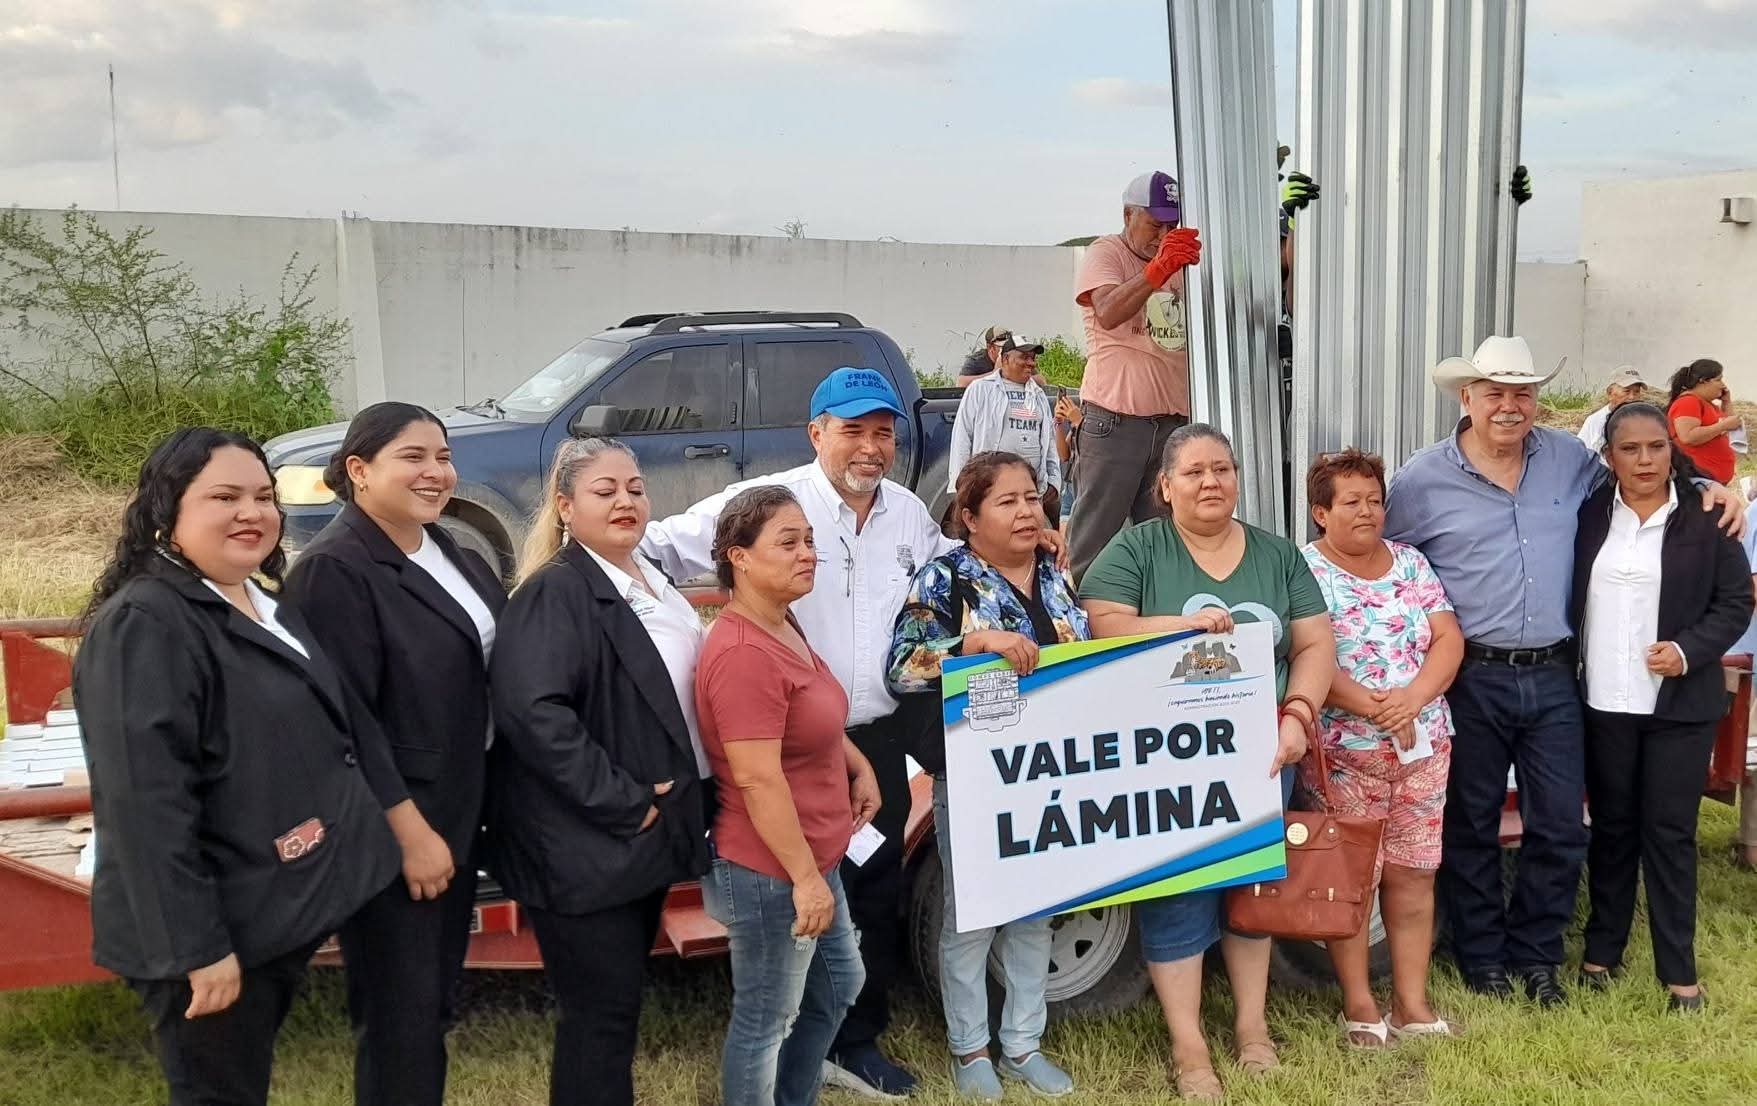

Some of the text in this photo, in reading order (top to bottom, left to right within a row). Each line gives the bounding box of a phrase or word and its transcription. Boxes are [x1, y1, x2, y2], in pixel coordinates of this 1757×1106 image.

[844, 380, 859, 389] DE
[847, 373, 881, 384] FRANK
[1008, 417, 1038, 431] TEAM
[991, 719, 1237, 785] VALE POR
[997, 781, 1241, 859] LÁMINA
